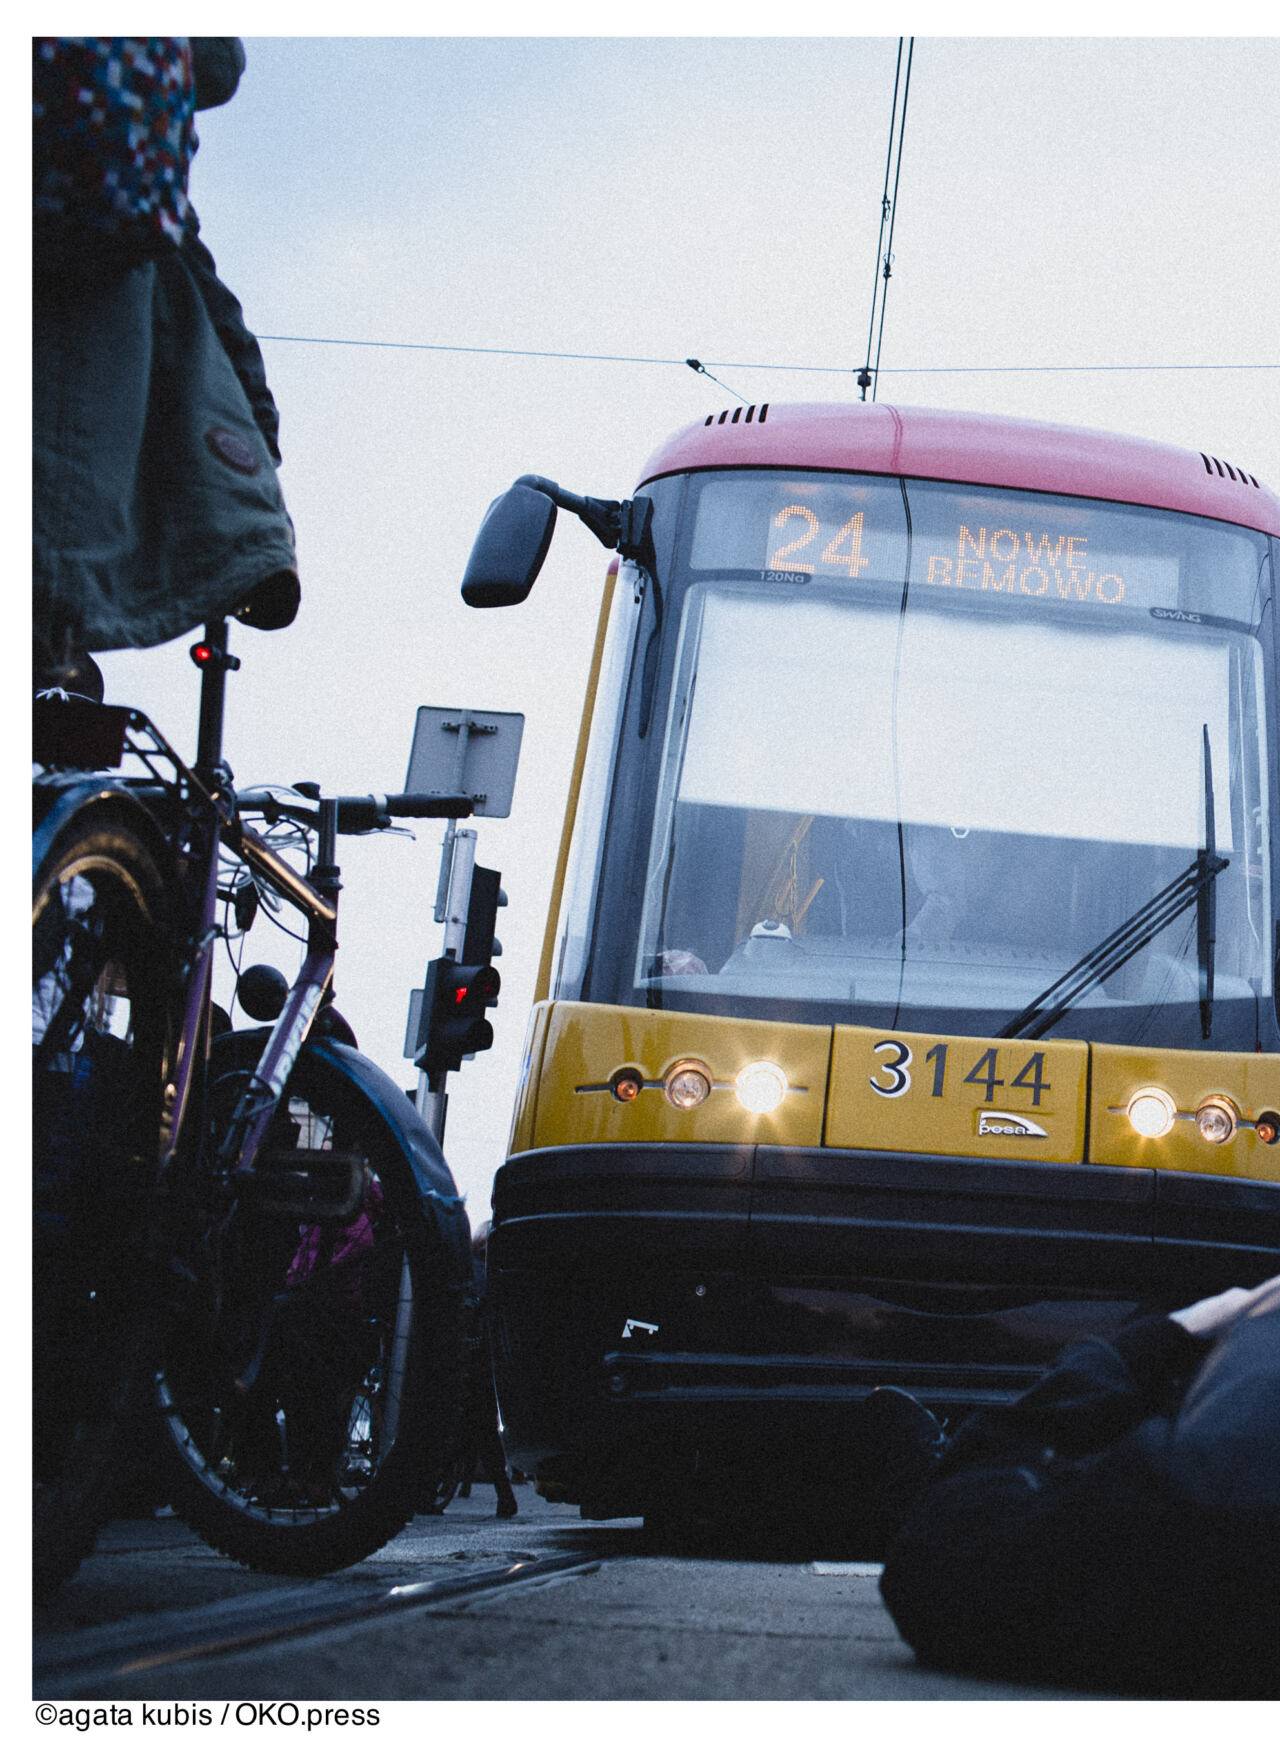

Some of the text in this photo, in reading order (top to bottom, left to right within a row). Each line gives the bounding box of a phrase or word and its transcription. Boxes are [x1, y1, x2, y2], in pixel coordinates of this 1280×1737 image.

[769, 505, 869, 577] 24
[957, 524, 1088, 569] NOWE
[760, 571, 805, 583] 120Na
[927, 556, 1125, 603] BEMOWO
[1152, 609, 1201, 623] SWING
[870, 1040, 1051, 1106] 3144
